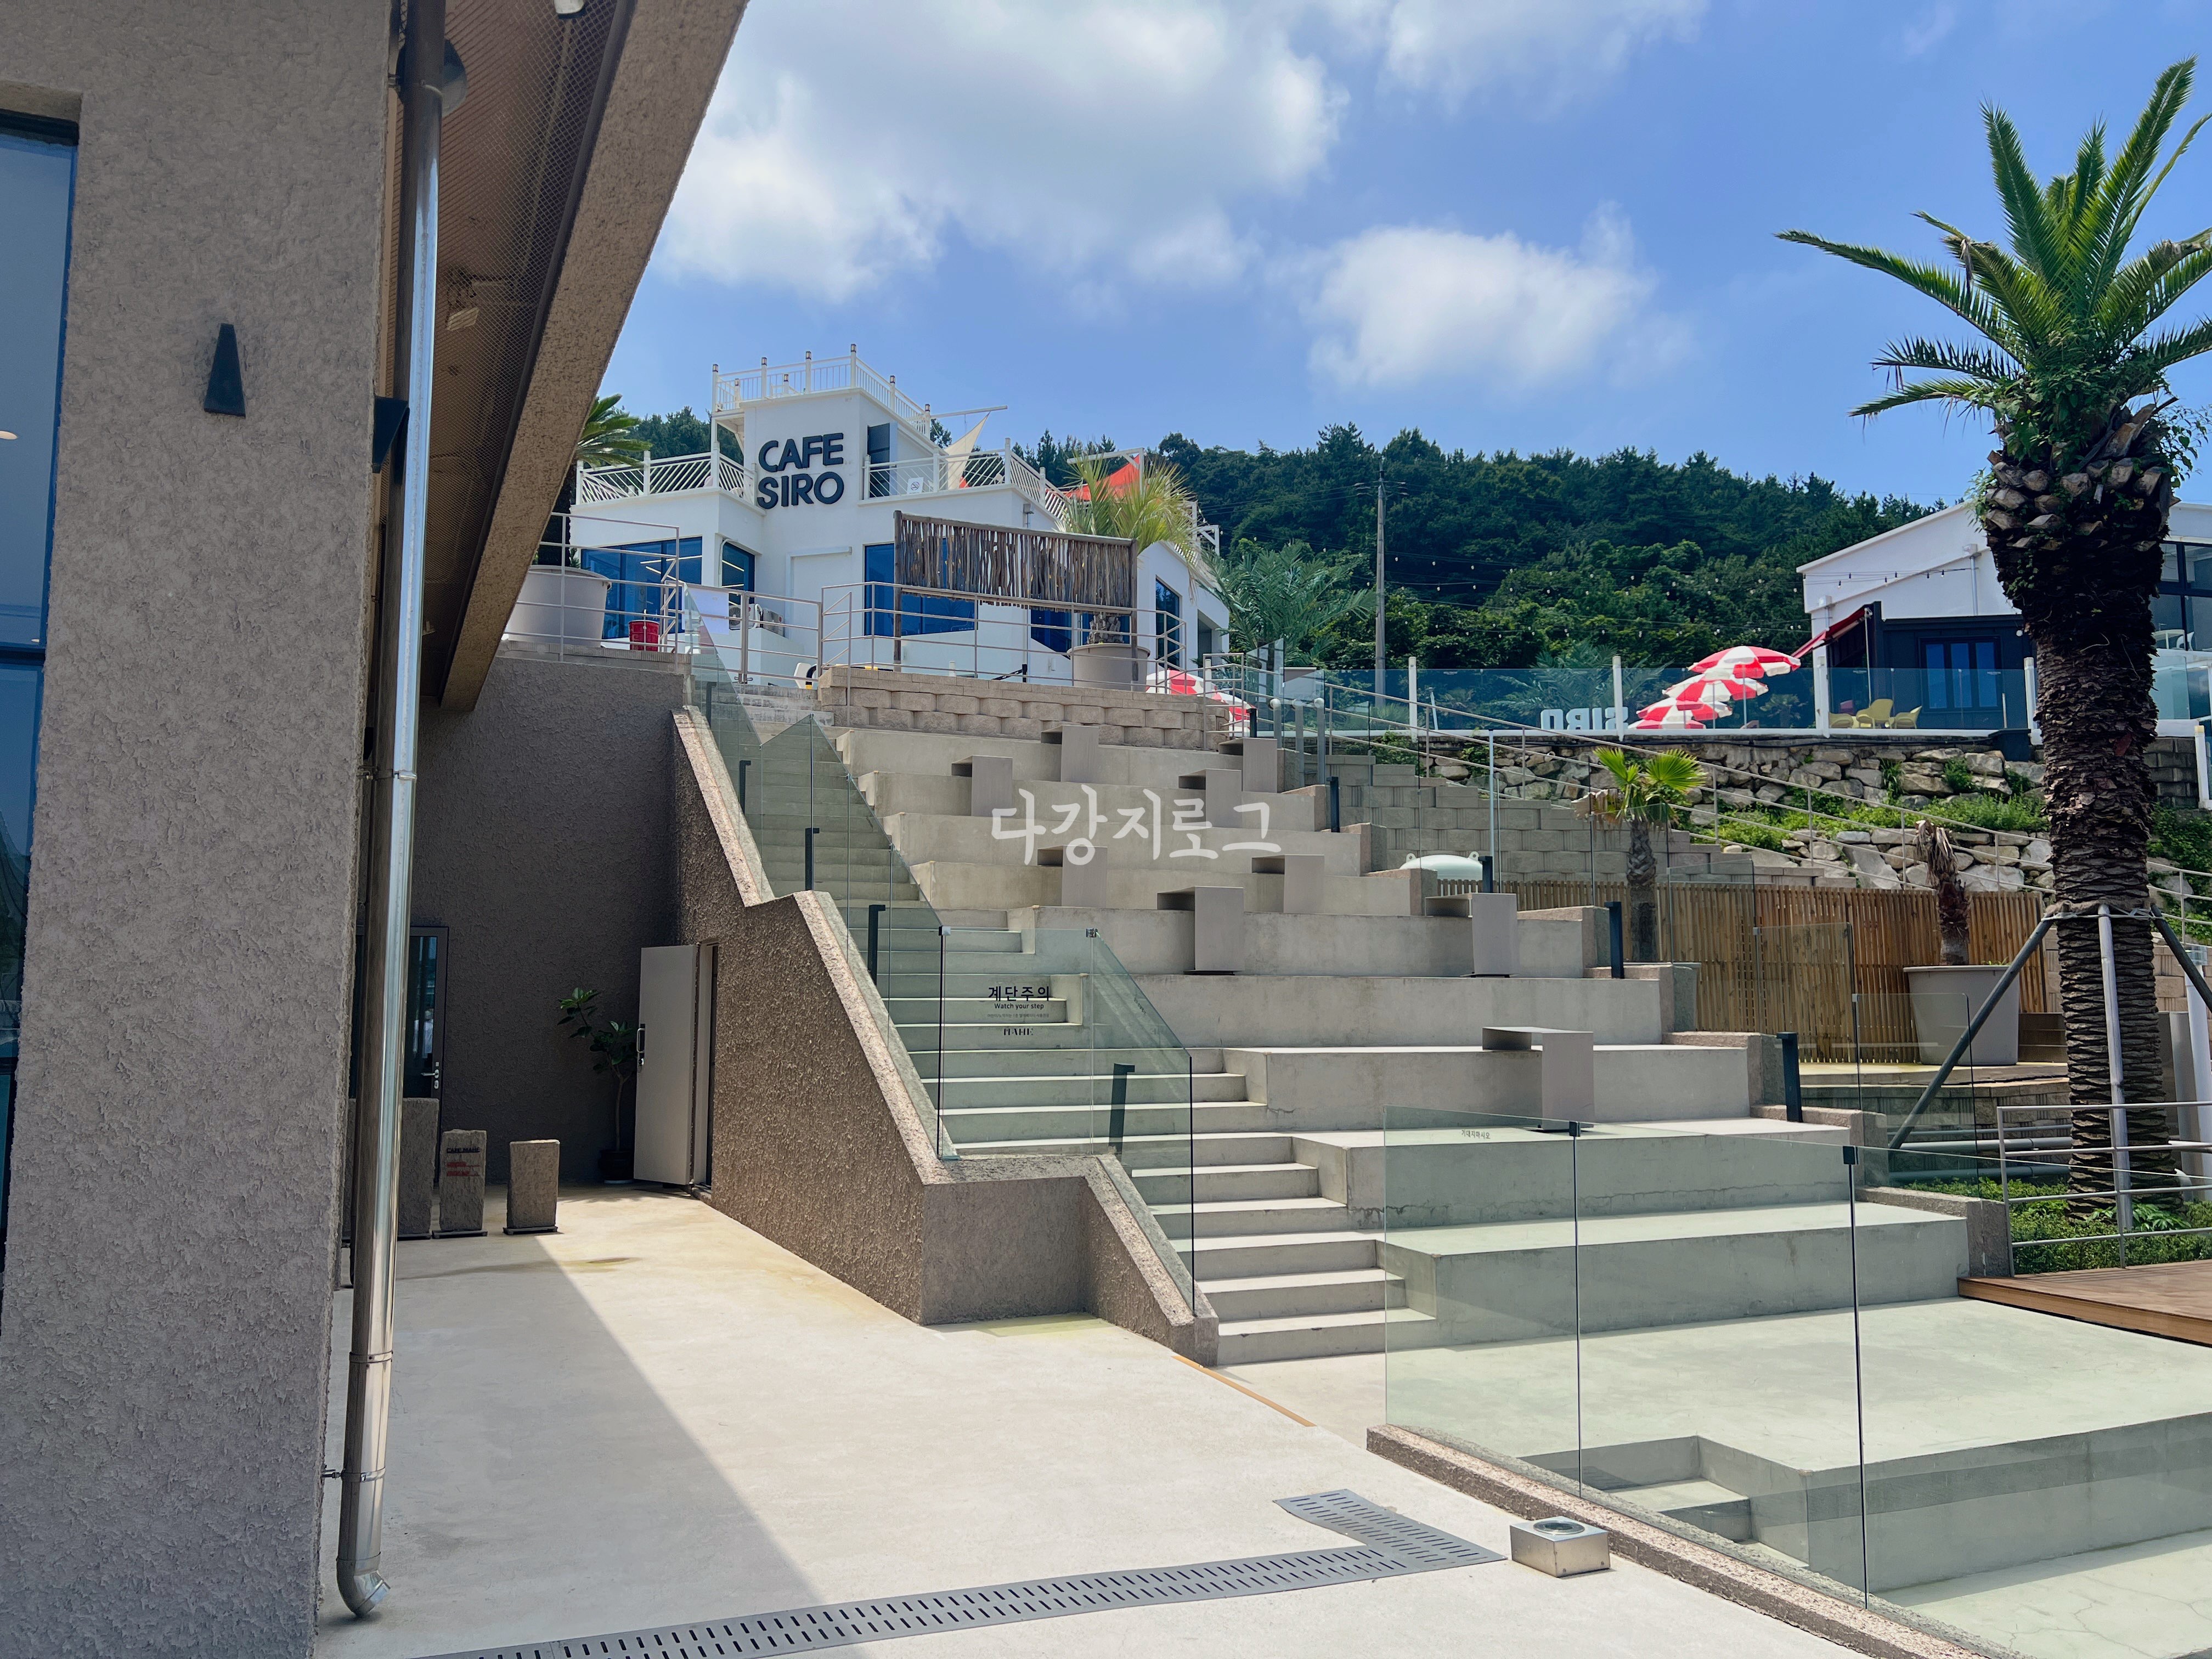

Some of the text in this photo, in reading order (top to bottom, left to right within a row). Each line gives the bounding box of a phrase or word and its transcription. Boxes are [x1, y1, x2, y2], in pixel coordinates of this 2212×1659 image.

[758, 432, 844, 472] CAFE
[757, 471, 844, 509] SIRO
[988, 986, 1049, 1002] 계단주의
